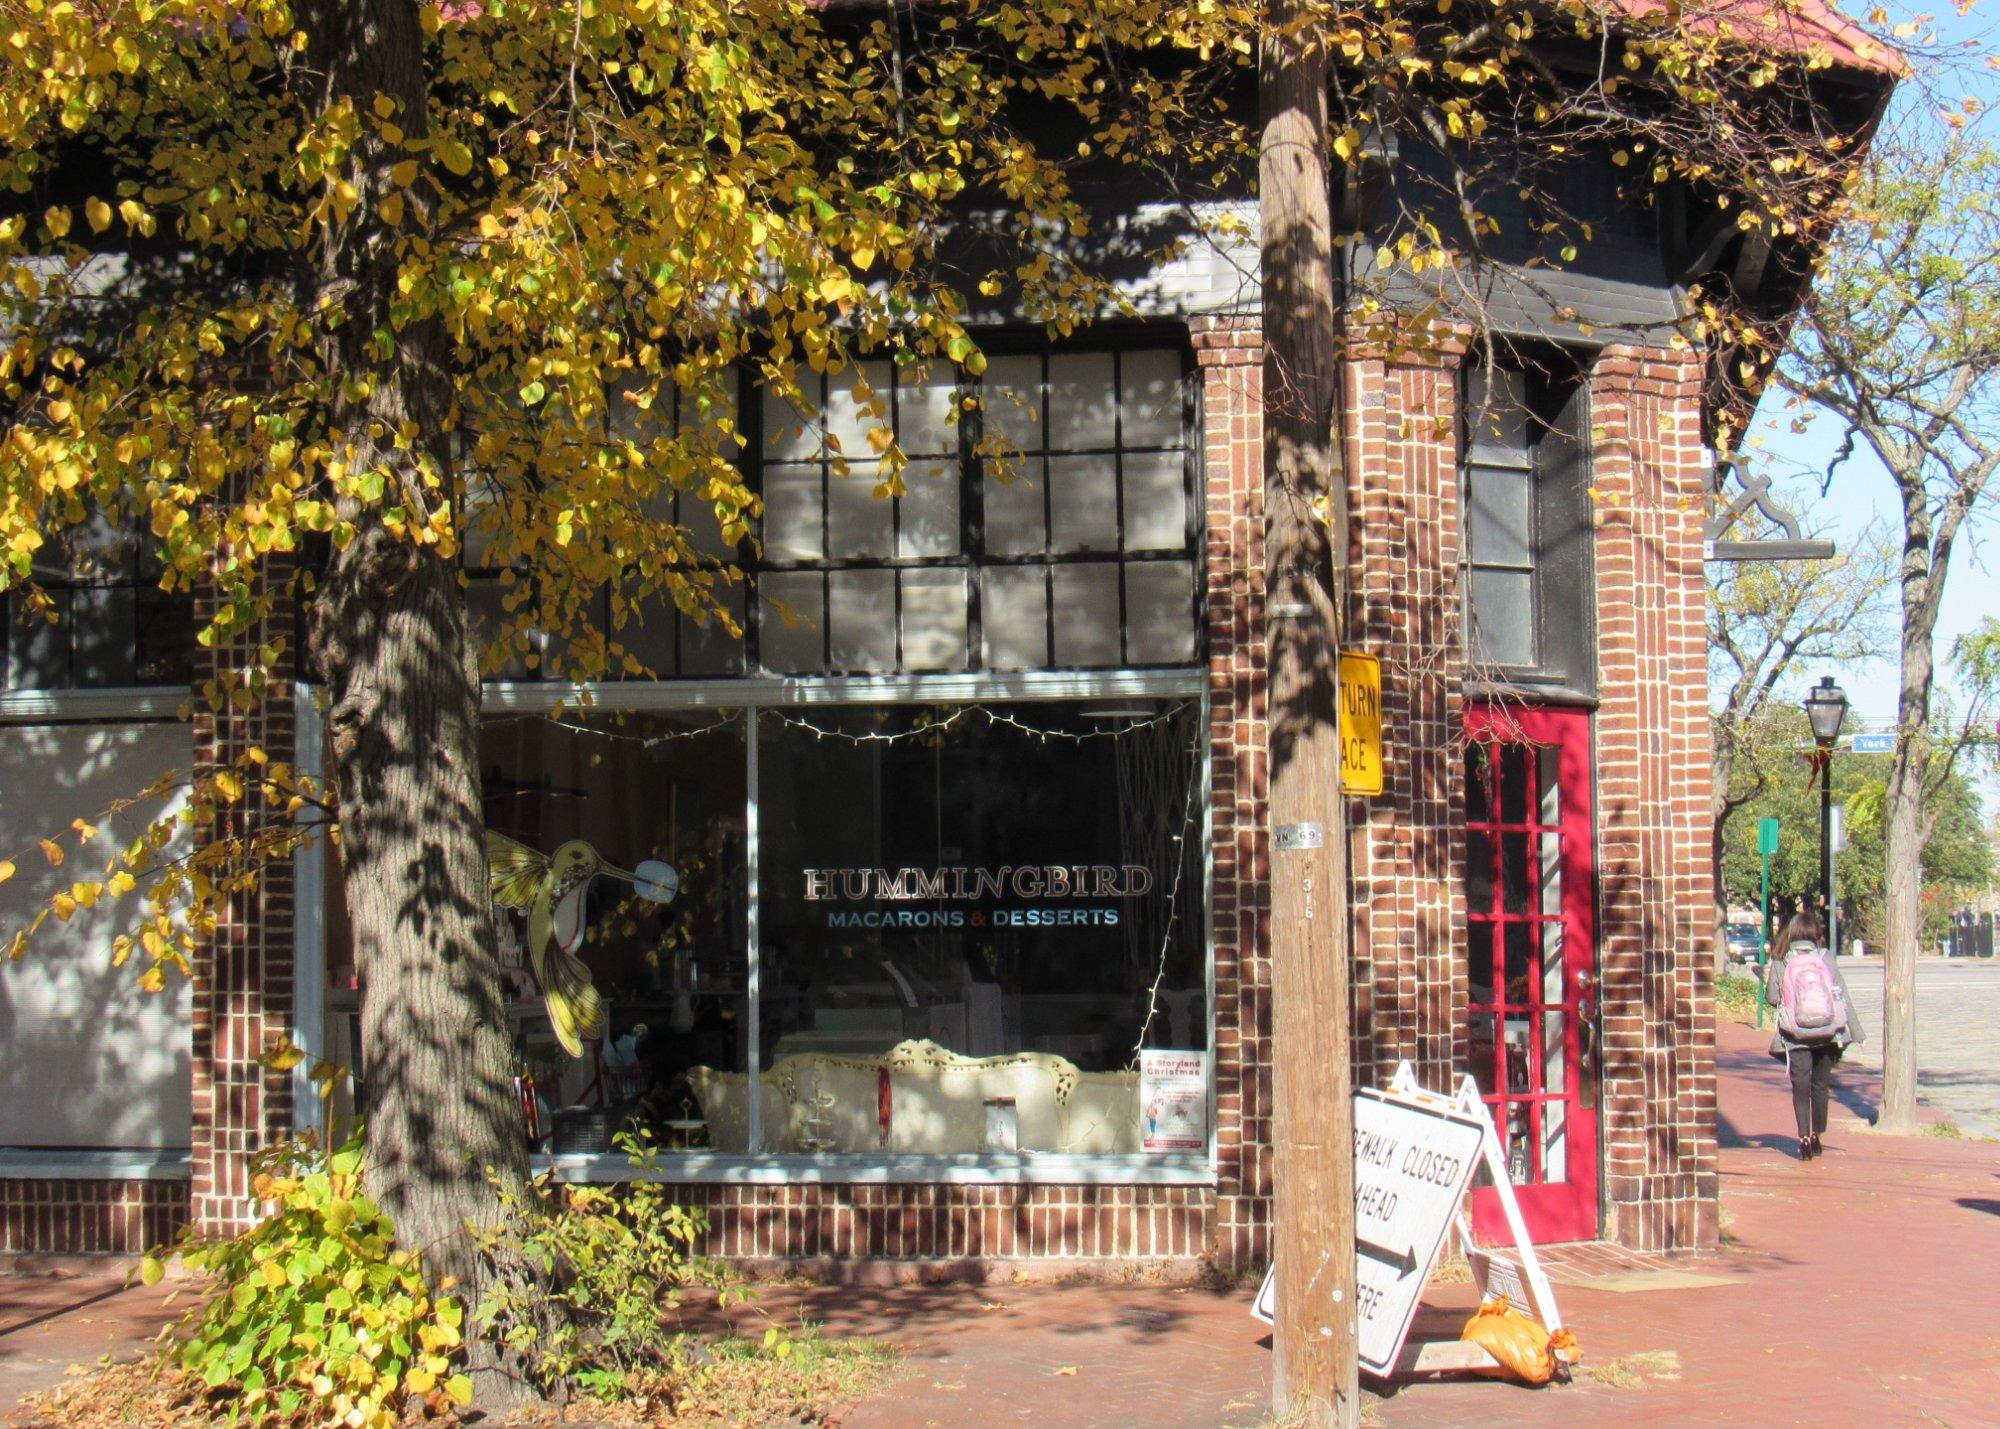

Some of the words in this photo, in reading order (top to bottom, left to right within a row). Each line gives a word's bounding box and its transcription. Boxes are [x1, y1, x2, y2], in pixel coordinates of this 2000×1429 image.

[1340, 681, 1376, 718] TURN
[802, 866, 1153, 900] HUMMINGBIRD
[828, 910, 965, 928] MACARONS
[970, 911, 986, 927] &
[993, 908, 1119, 927] DESSERTS
[1147, 1067, 1200, 1076] Christmas
[1157, 1059, 1200, 1069] Storyland
[1401, 1144, 1460, 1188] CLOSED
